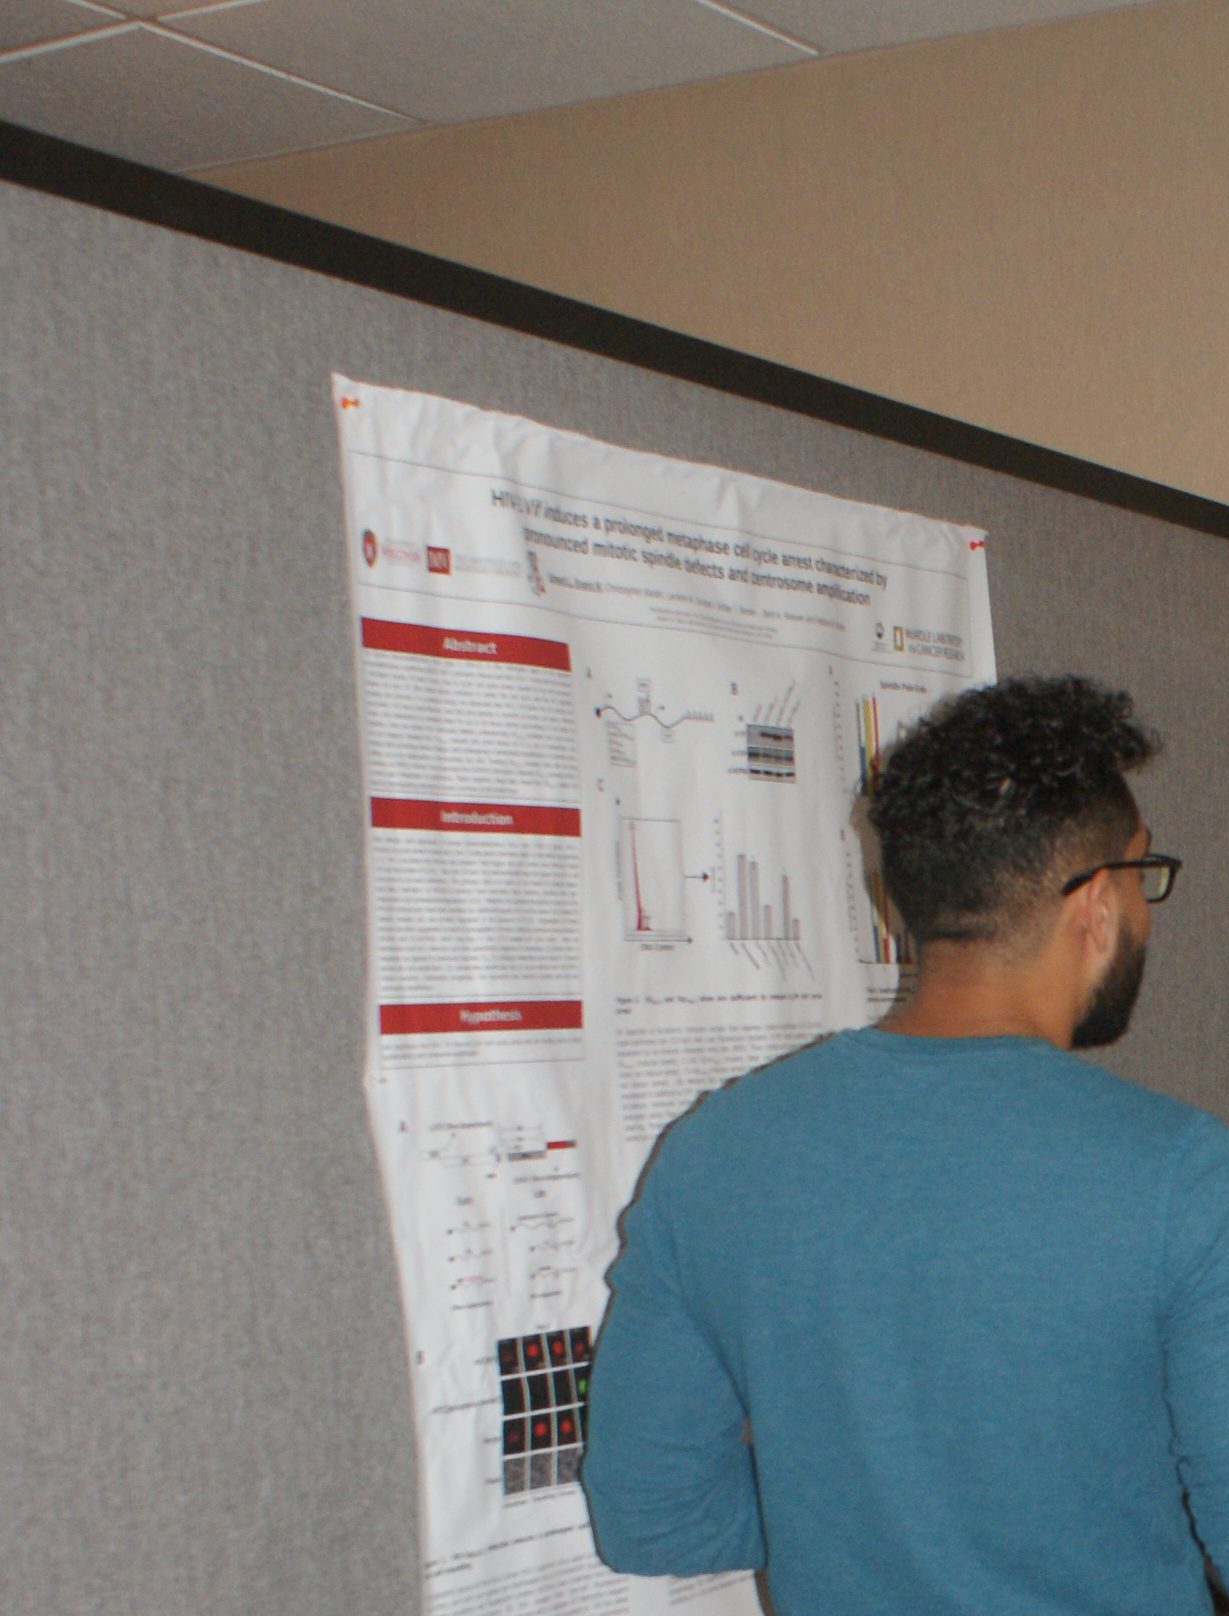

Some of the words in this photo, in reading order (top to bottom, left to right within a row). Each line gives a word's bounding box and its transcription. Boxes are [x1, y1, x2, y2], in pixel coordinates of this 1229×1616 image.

[544, 504, 589, 528] induces
[593, 516, 602, 530] a
[604, 517, 664, 544] prolonged
[666, 530, 729, 555] metaphase
[734, 543, 750, 558] cell
[752, 548, 778, 566] cycle
[782, 553, 814, 571] arrest
[815, 556, 875, 585] characterized
[876, 570, 888, 590] by
[592, 541, 638, 562] mitotic
[641, 549, 682, 570] spindle
[684, 556, 725, 580] defects
[728, 567, 749, 583] and
[751, 571, 814, 593] centrosome
[443, 636, 497, 655] Abstract
[440, 810, 513, 826] Introduction
[460, 1008, 522, 1025] Hypothesis
